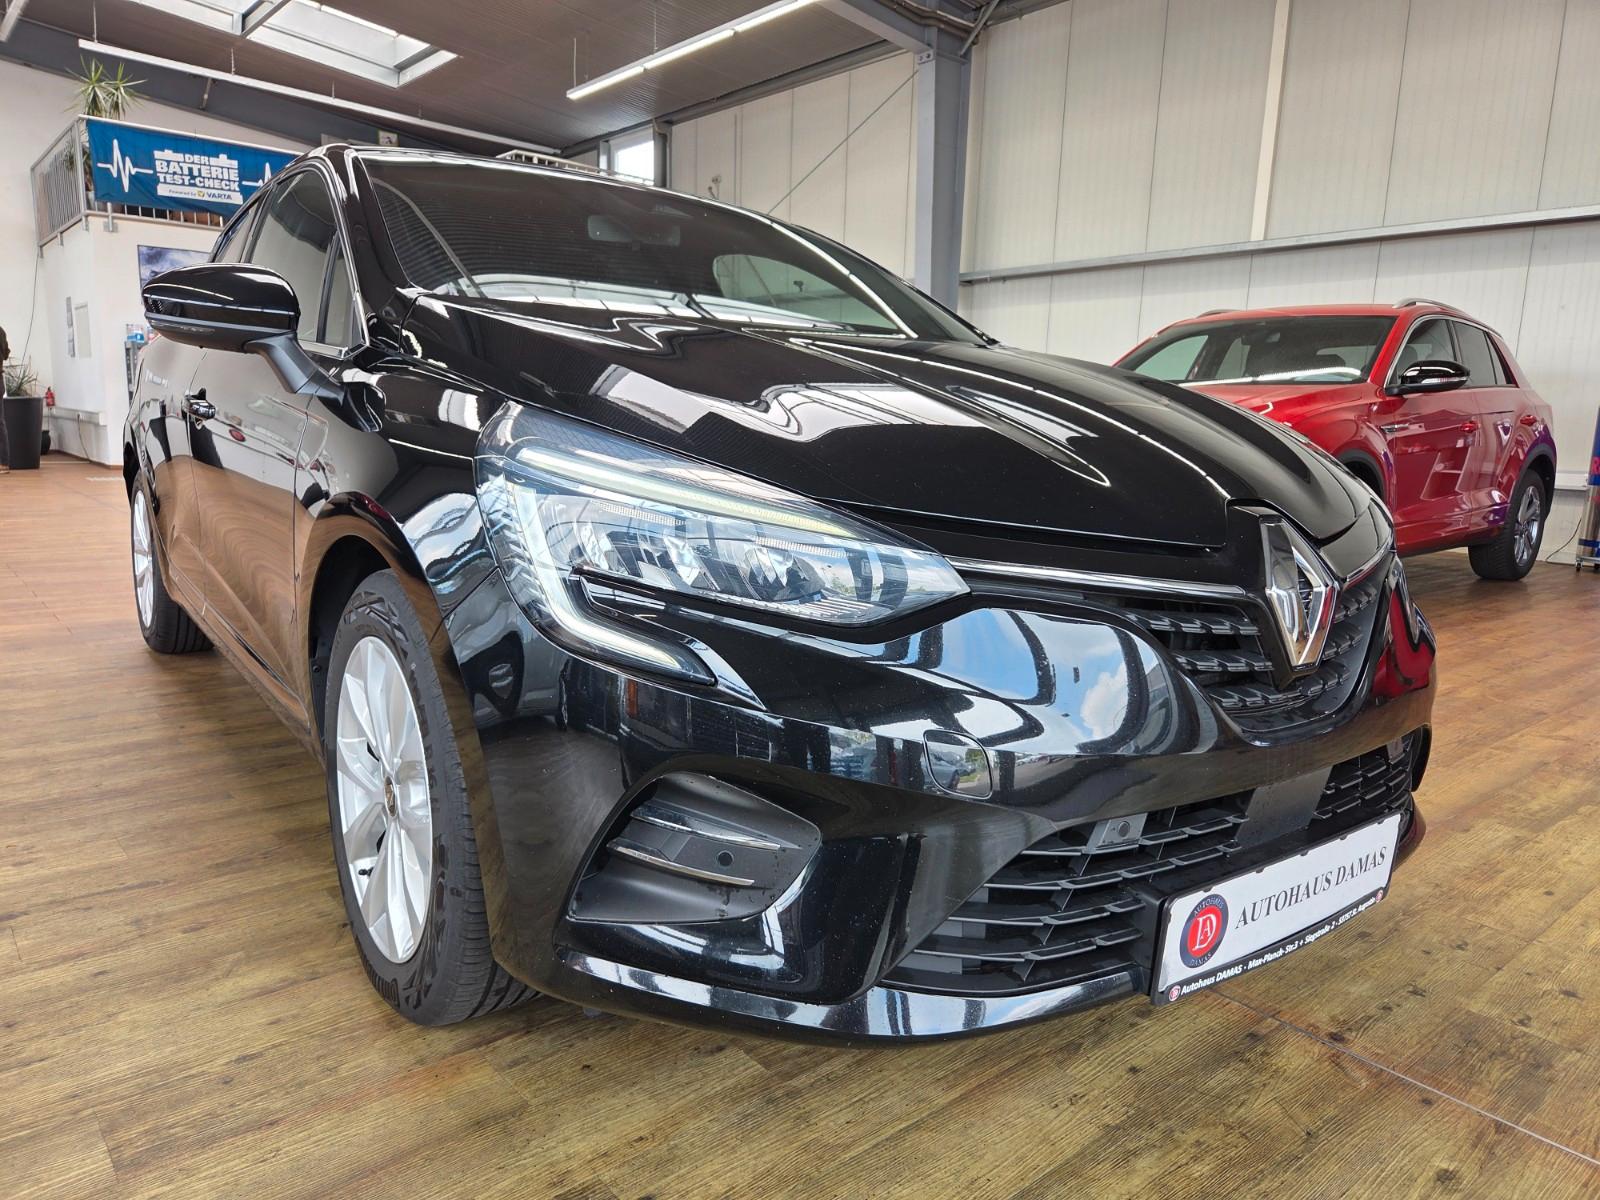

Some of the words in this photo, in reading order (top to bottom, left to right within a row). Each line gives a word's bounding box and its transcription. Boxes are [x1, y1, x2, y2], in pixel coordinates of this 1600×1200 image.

[184, 153, 210, 165] DER
[155, 160, 239, 180] BATTERIE
[157, 174, 239, 191] TEST-CHECK
[206, 192, 233, 200] VARTA
[1235, 871, 1333, 929] AUTOHAUS
[1335, 846, 1388, 886] DAMAS
[1181, 976, 1216, 996] Autohaus
[1216, 964, 1243, 982] DAMAS
